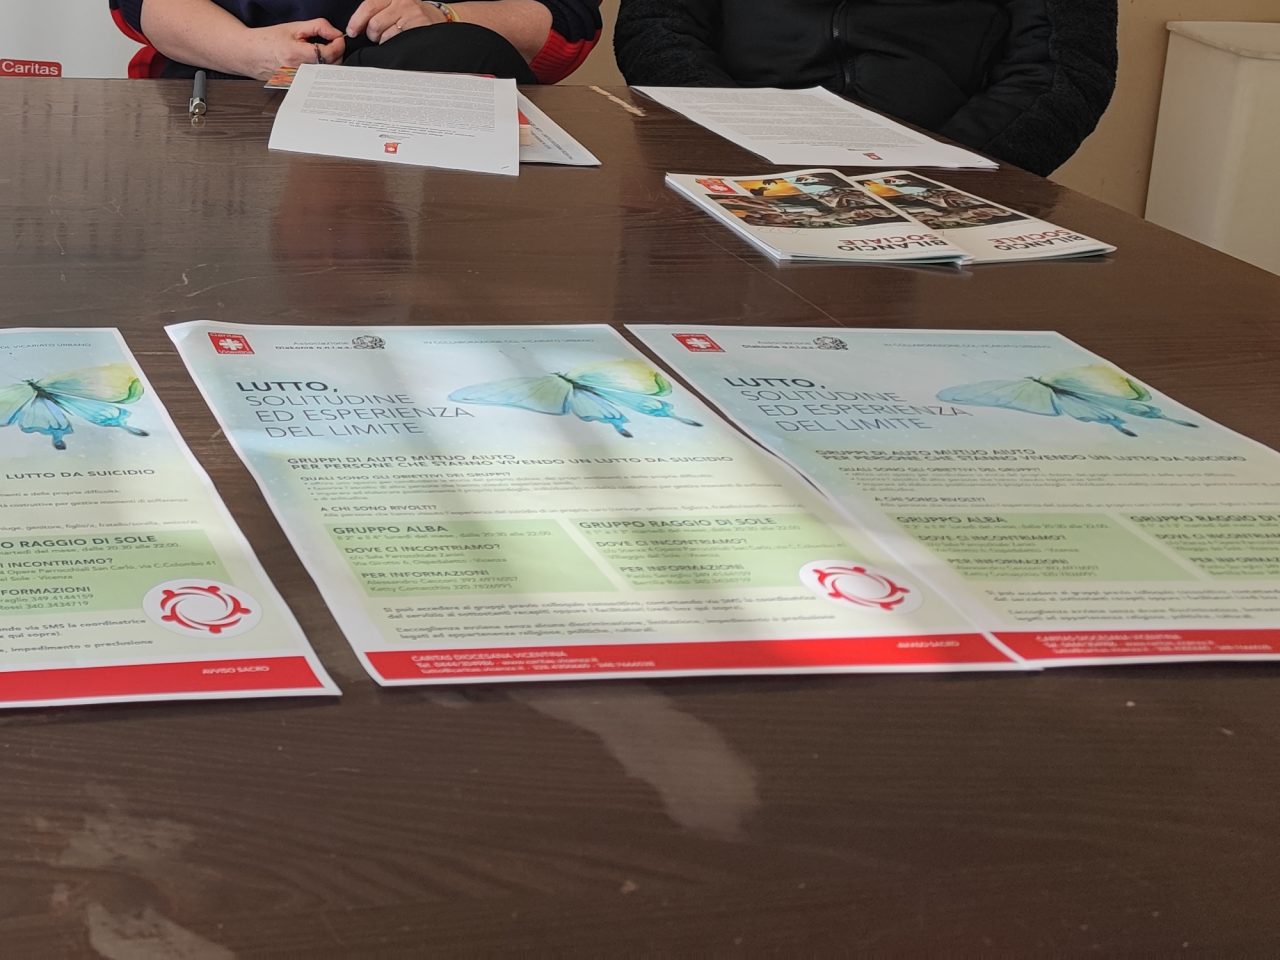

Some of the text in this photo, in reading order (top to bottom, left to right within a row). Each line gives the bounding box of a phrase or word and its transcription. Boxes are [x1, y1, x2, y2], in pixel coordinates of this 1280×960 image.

[1, 60, 59, 76] Caritas
[839, 234, 939, 246] SOCIALE
[988, 229, 1071, 244] SOCIALE
[993, 235, 1087, 250] BILANCIO
[837, 240, 948, 252] BILANCIO
[235, 380, 338, 392] LUTTO,
[723, 376, 825, 389] LUTTO,
[244, 393, 414, 406] SOLITUDINE
[739, 389, 906, 402] SOLITUDINE
[254, 406, 474, 422] ED ESPERIENZA
[756, 404, 973, 416] ED ESPERIENZA
[263, 421, 423, 438] DEL LIMITE
[774, 417, 932, 432] DEL LIMITE
[5, 471, 56, 479] LUTTO
[86, 468, 155, 476] SUICIDIO
[332, 524, 448, 534] GRUPPO ALBA
[578, 516, 776, 529] GRUPPO RAGGIO DI SOLE
[18, 538, 87, 548] RAGGIO
[91, 537, 109, 545] DI
[113, 534, 156, 544] SOLE
